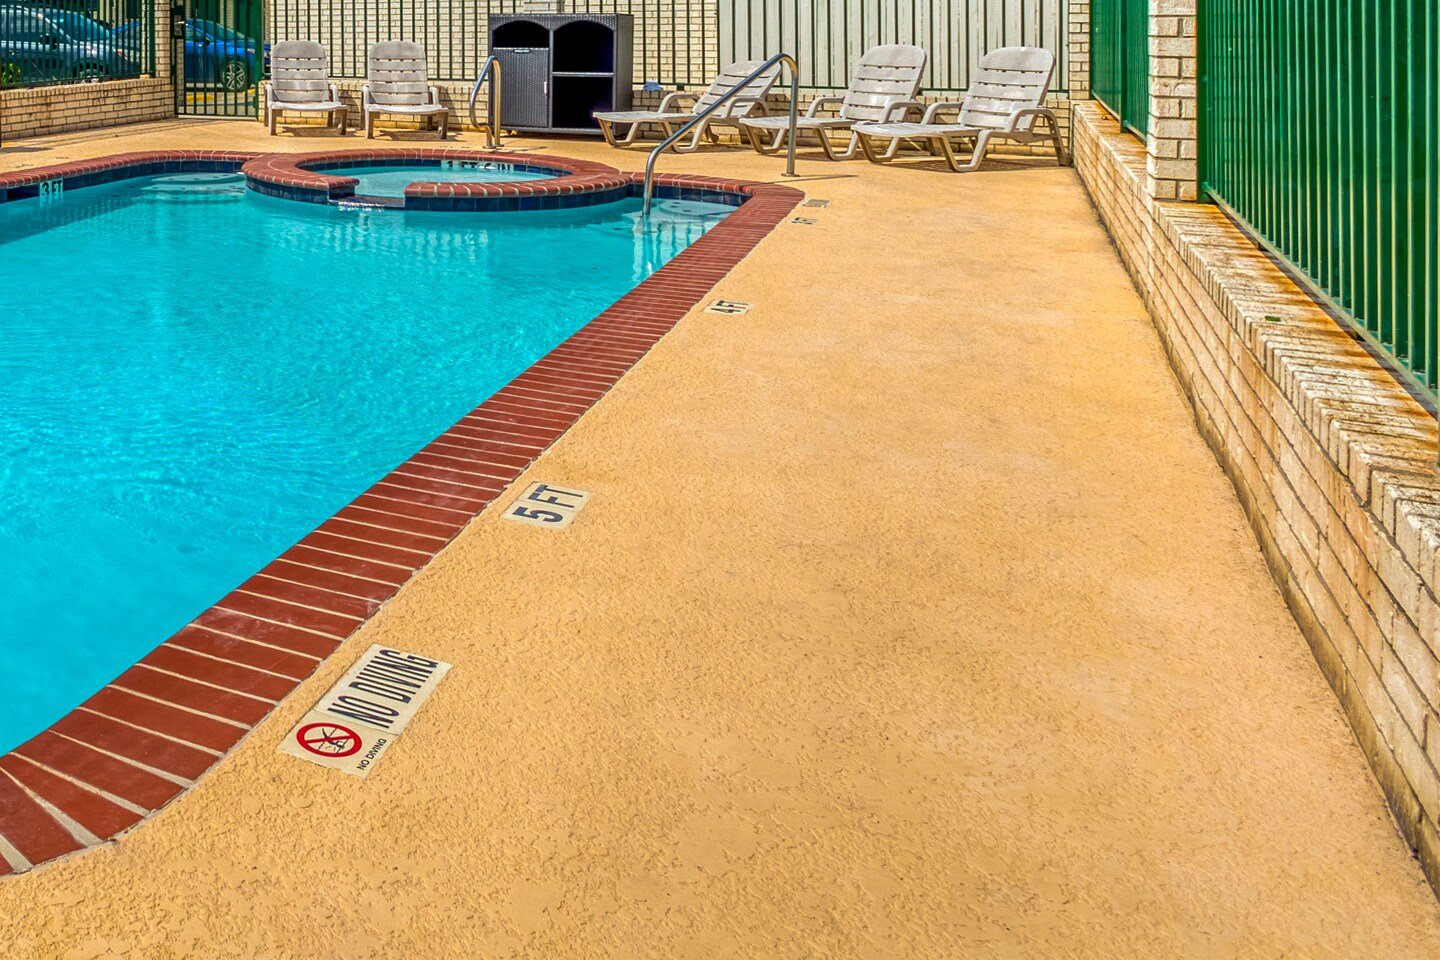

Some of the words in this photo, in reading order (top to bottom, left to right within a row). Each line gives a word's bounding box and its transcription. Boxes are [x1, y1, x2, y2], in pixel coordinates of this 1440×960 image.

[41, 181, 50, 196] 3
[51, 179, 63, 195] FT
[527, 484, 584, 508] FT
[512, 506, 564, 523] 5
[348, 649, 439, 704] DIVING
[326, 695, 400, 730] NO
[356, 758, 370, 771] NO
[365, 738, 387, 760] DIVING
